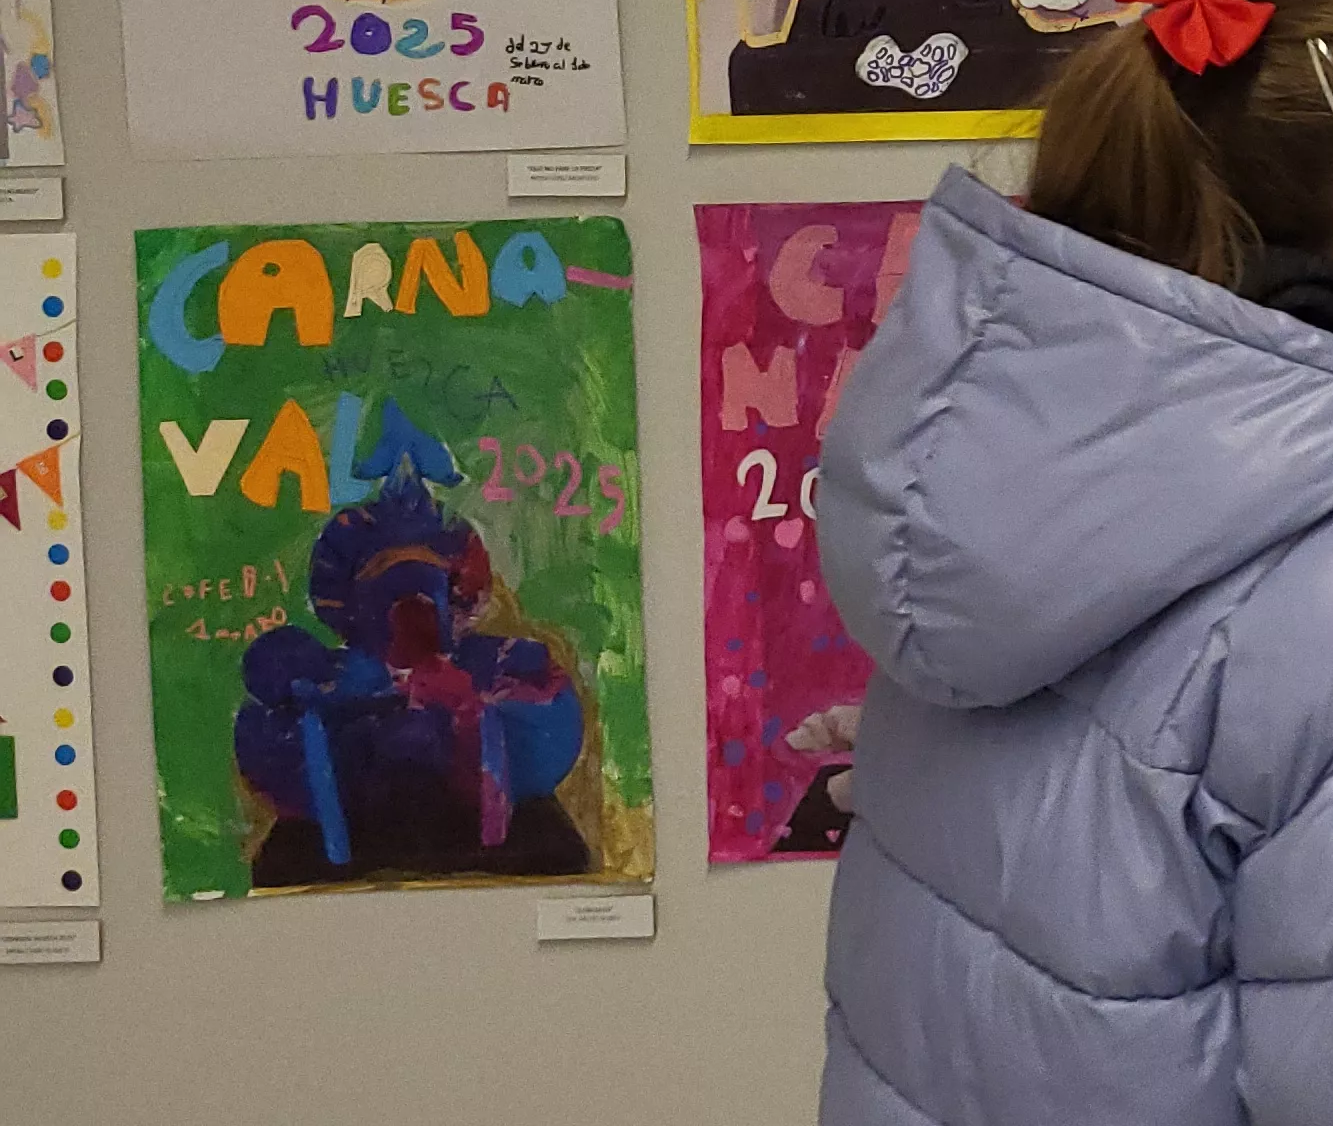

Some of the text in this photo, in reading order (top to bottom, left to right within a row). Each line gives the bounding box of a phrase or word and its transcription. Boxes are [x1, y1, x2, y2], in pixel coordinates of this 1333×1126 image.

[291, 5, 486, 59] 2025
[303, 75, 511, 121] HUESCA
[477, 435, 627, 536] 2025
